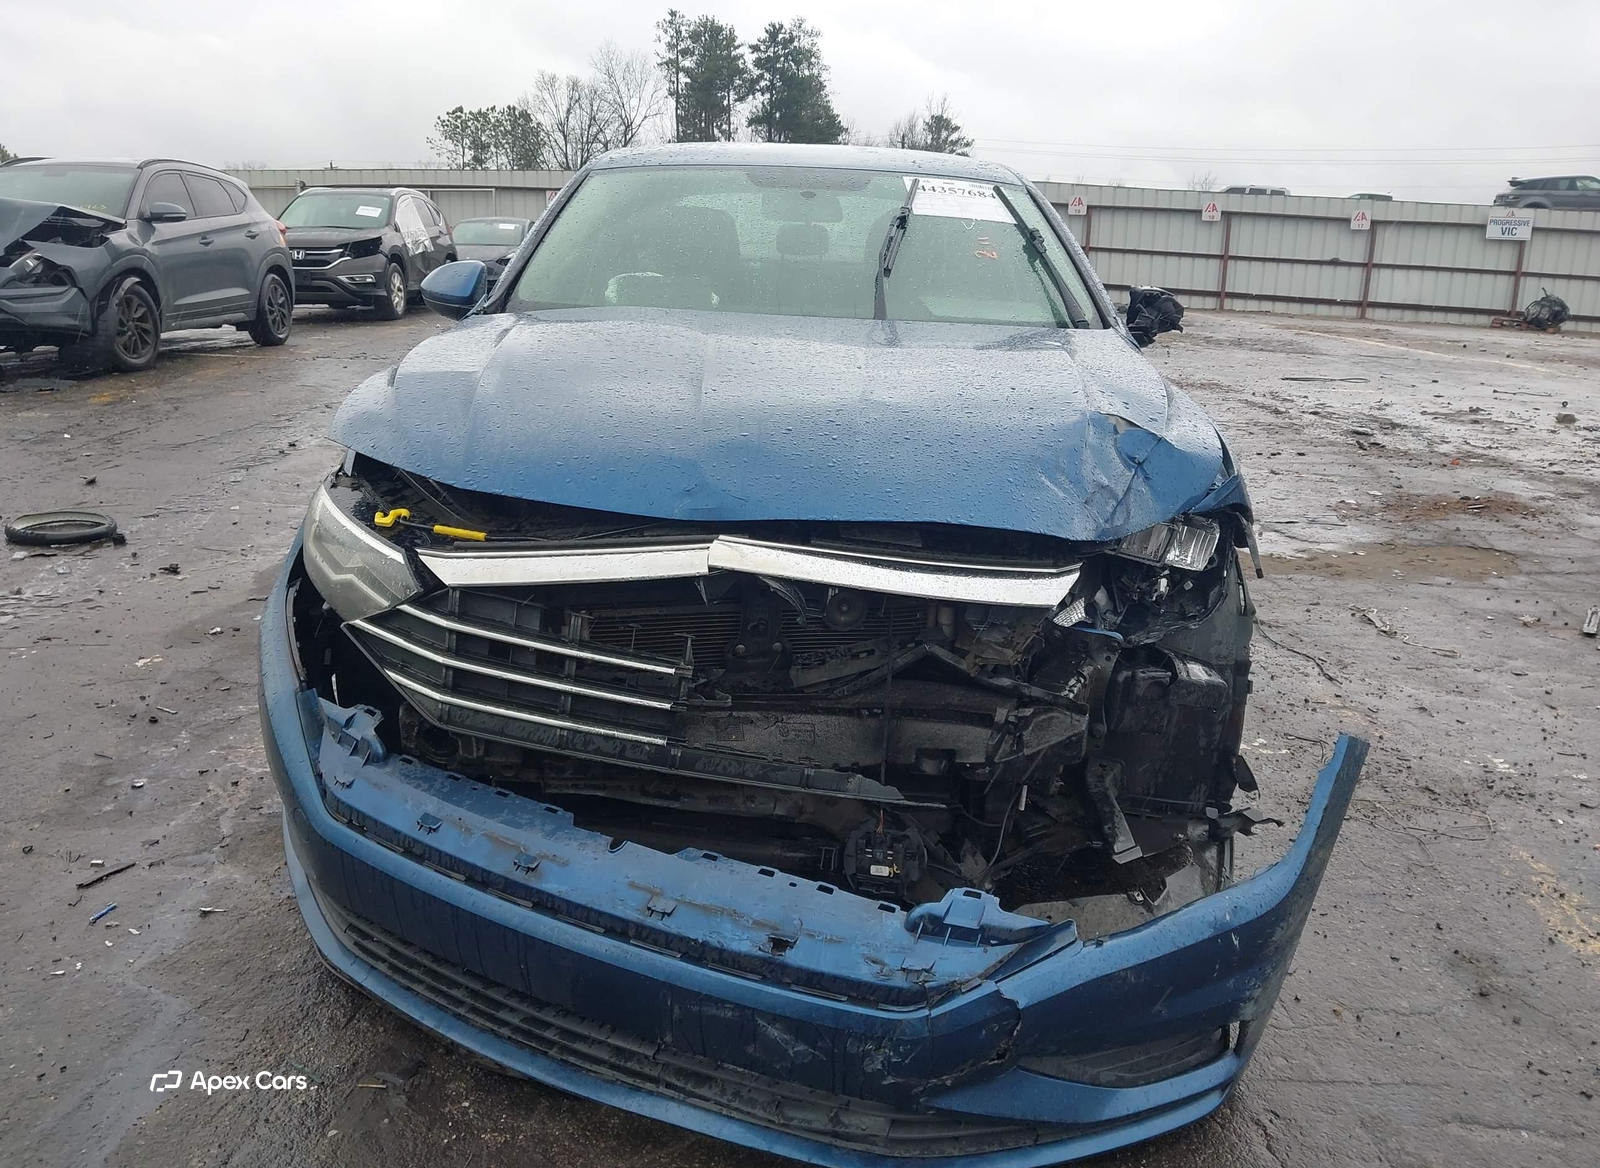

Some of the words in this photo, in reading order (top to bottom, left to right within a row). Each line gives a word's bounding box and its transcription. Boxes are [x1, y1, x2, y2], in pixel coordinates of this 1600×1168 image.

[917, 184, 997, 200] 44357684
[1489, 218, 1531, 227] PROGRESSIVE
[1500, 226, 1518, 237] VIC
